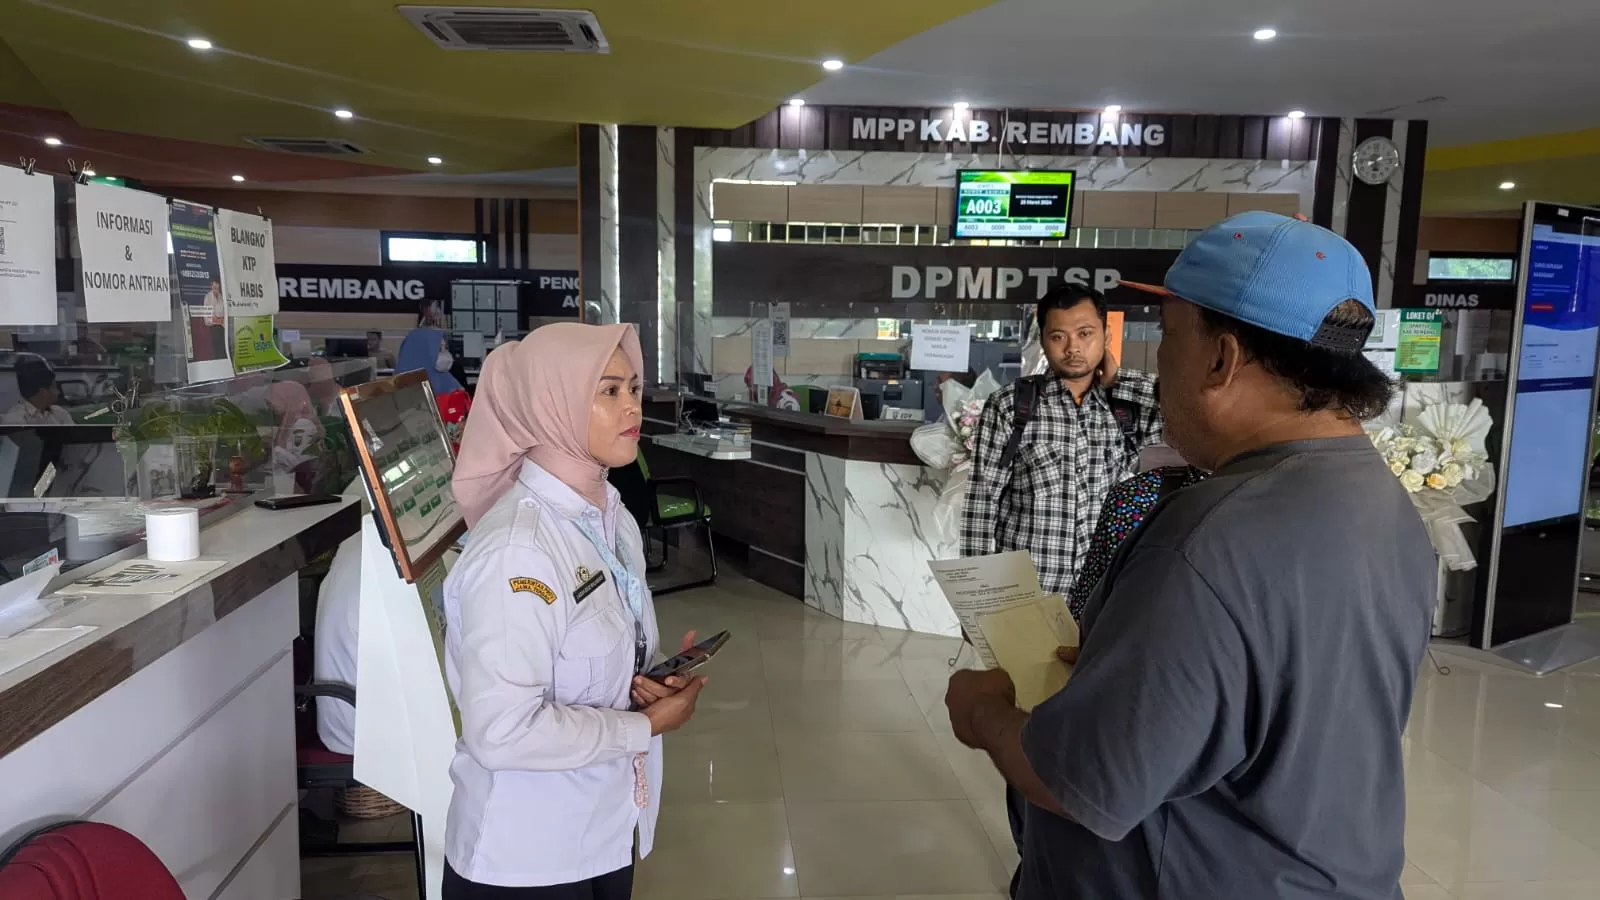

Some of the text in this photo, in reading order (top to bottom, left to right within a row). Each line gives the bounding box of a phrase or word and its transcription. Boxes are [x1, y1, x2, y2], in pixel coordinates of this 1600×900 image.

[852, 117, 1165, 147] MPP KAB. REMBANG
[966, 199, 1002, 214] A003
[96, 211, 153, 236] INFORMASI
[230, 227, 266, 248] BLANGKO
[124, 245, 133, 261] &
[242, 255, 256, 271] KTP
[85, 271, 127, 290] NOMOR
[129, 275, 169, 293] ANTRIAN
[240, 282, 264, 298] HABIS
[279, 277, 425, 300] REMBANG
[891, 265, 1122, 300] DPMPTSP
[1425, 293, 1479, 307] DINAS
[1406, 311, 1425, 320] LOKET
